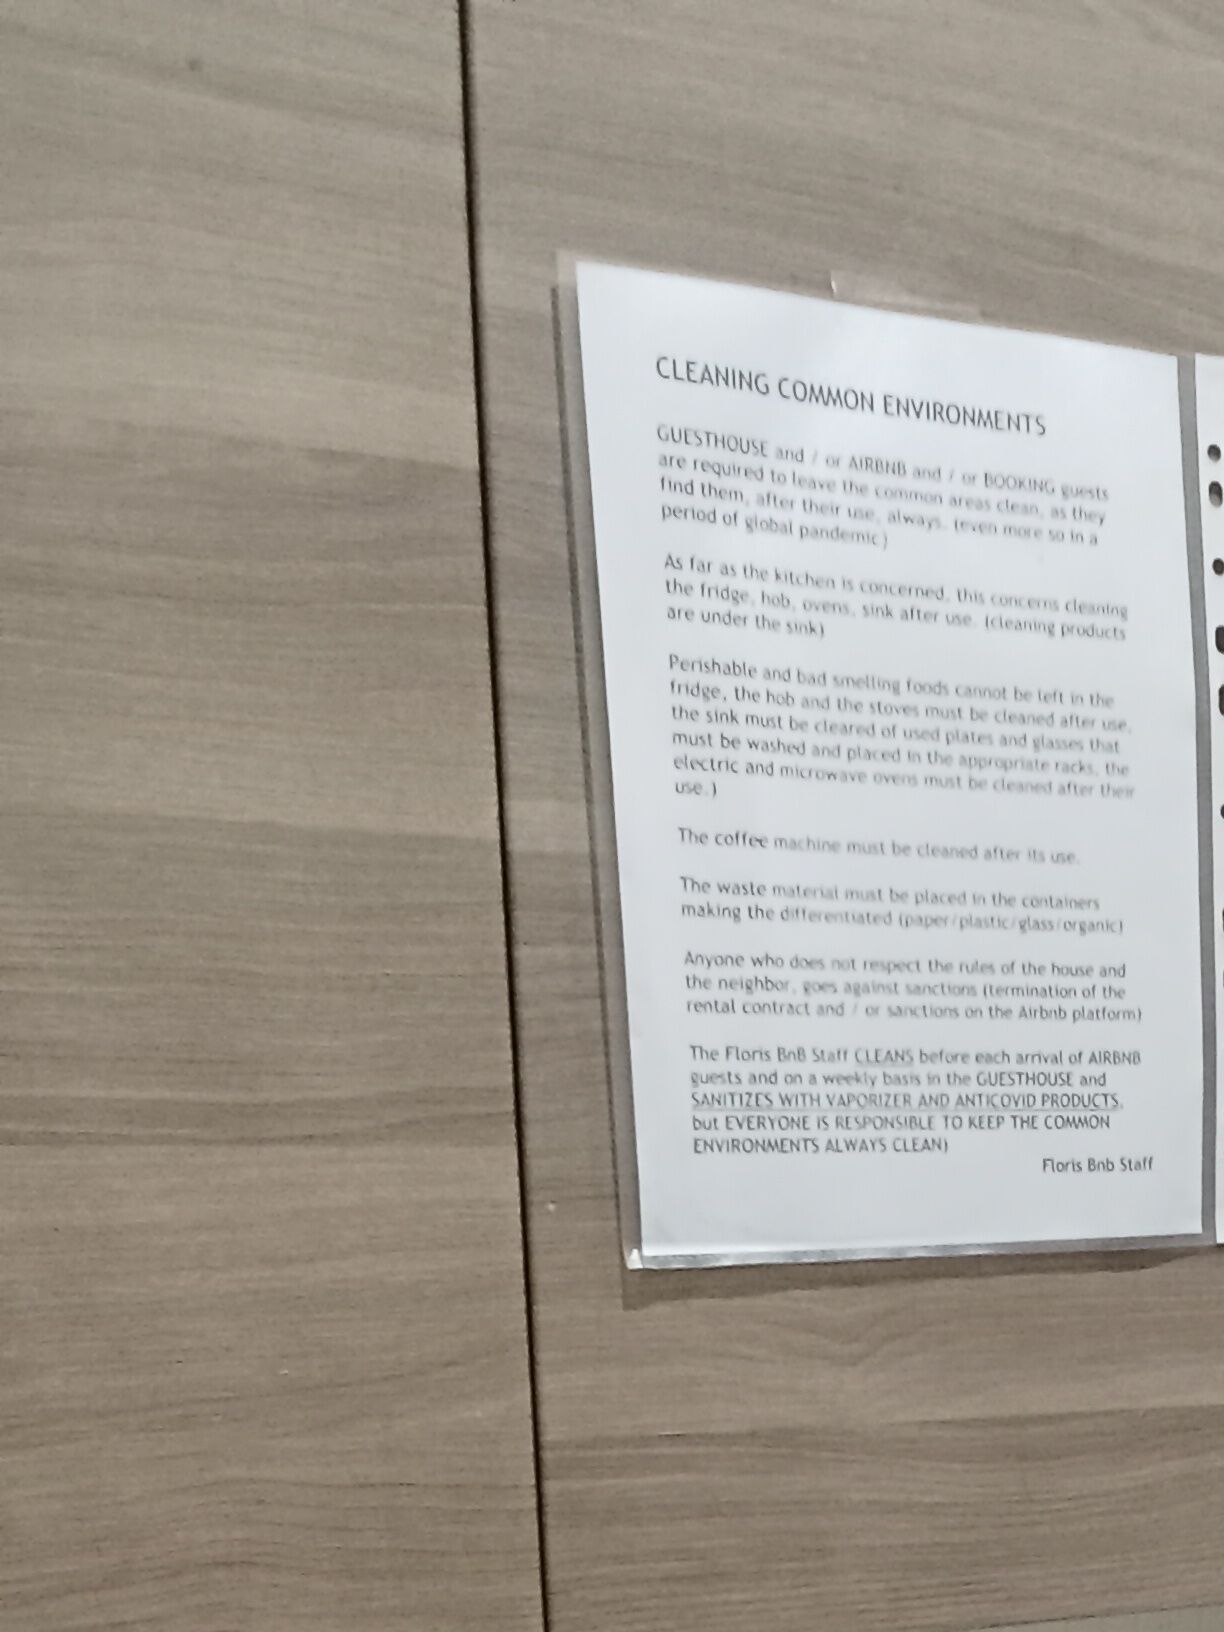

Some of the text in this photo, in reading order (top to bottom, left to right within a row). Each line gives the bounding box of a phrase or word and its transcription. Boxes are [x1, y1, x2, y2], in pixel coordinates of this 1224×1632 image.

[655, 357, 1045, 434] CLEANING COMMON ENVIRONMENTS
[656, 426, 768, 457] GUESTHOUSE
[775, 446, 804, 462] and
[825, 454, 841, 468] or
[848, 453, 907, 476] AIRBNB
[912, 464, 941, 480] and
[961, 471, 977, 485] or
[983, 470, 1055, 493] BOOKING
[1060, 482, 1108, 499] guests
[658, 456, 687, 472] are
[693, 461, 764, 483] required
[770, 468, 787, 486] to
[791, 471, 836, 492] leave
[842, 478, 869, 496] the
[874, 486, 943, 506] common
[948, 495, 991, 511] areas
[1050, 506, 1067, 519] as
[1071, 504, 1105, 528] they
[661, 507, 887, 551] period of global pandemic)
[664, 554, 683, 572] As
[689, 557, 712, 576] far
[719, 565, 737, 579] as
[742, 565, 769, 583] the
[774, 569, 835, 591] kitchen
[841, 577, 854, 594] is
[956, 589, 985, 607] this
[990, 596, 1059, 613] concerns
[1064, 598, 1127, 622] cleaning
[667, 610, 824, 640] are under the sink)
[668, 655, 1114, 708] Perishable and bad smelling foods cannot be left in the
[671, 705, 1119, 755] the sink must be cleared of used plates and glasses that
[674, 780, 716, 799] use.)
[679, 829, 708, 847] The
[714, 832, 768, 851] coffee
[773, 837, 841, 856] machine
[846, 841, 885, 858] must
[891, 842, 911, 859] be
[916, 843, 978, 862] cleaned
[983, 846, 1020, 864] after
[1026, 848, 1045, 865] its
[681, 904, 741, 926] making
[747, 906, 774, 923] the
[779, 907, 892, 928] differentiated
[689, 1045, 1140, 1065] The Floris BnB Staff CLEANS before each arrival of AIRBNB
[690, 1069, 1106, 1091] guests and on a weekly basis in the GUESTHOUSE and
[691, 1091, 773, 1108] SANITIZES
[778, 1091, 820, 1108] WITH
[825, 1092, 912, 1108] VAPORIZER
[917, 1092, 949, 1109] AND
[955, 1092, 1036, 1109] ANTICOVID
[692, 1114, 1109, 1131] but EVERYONE IS RESPONSIBLE TO KEEP THE COMMON
[693, 1137, 948, 1155] ENVIRONMENTS ALWAYS CLEAN)
[1042, 1157, 1153, 1173] Floris Bnb Staff
